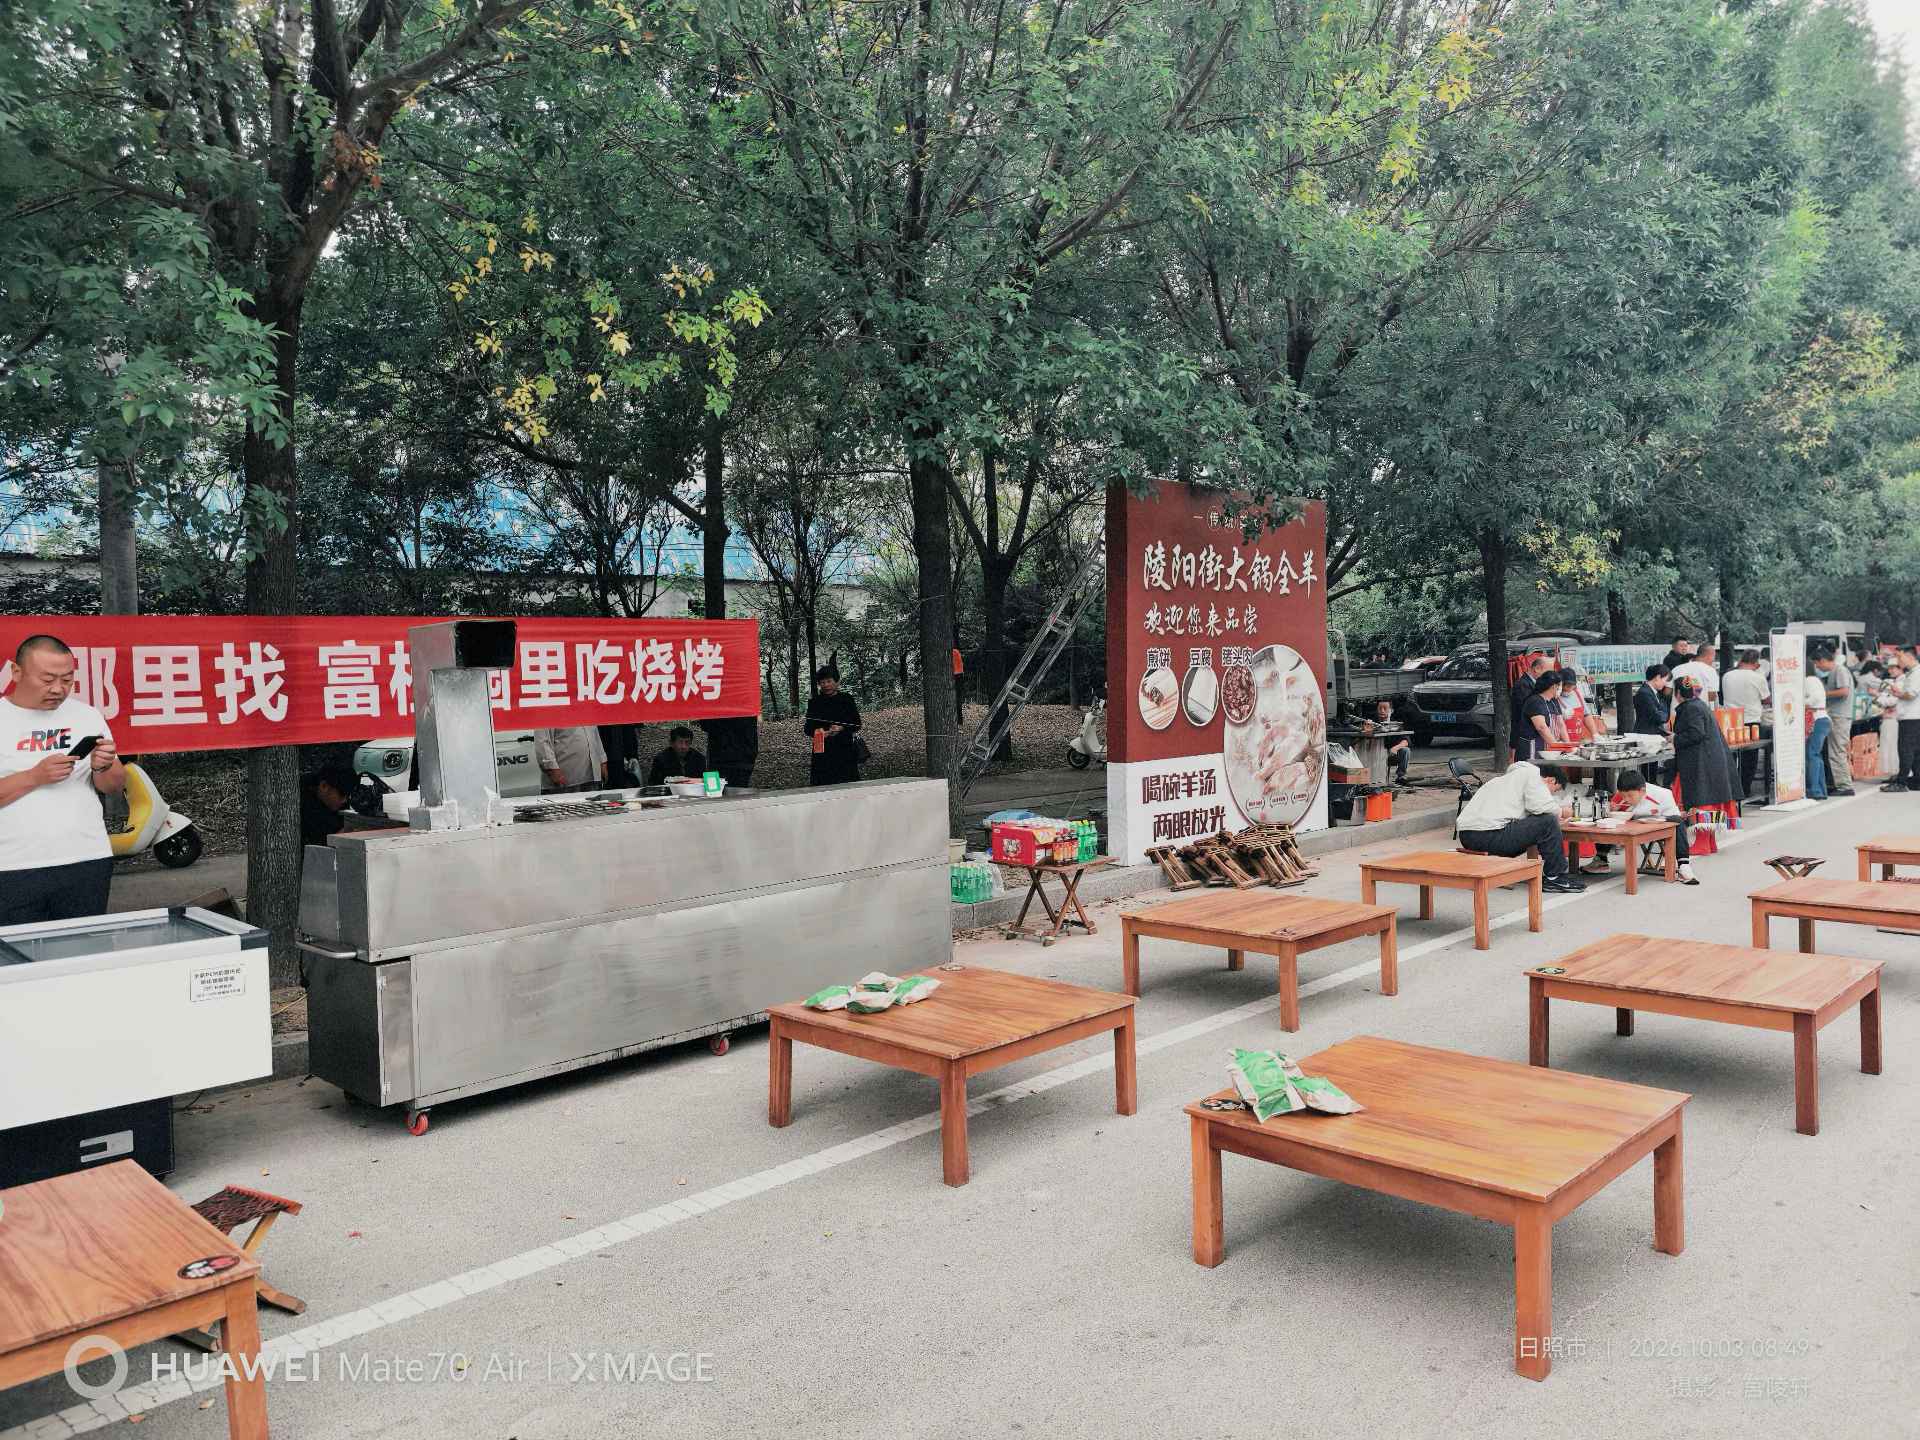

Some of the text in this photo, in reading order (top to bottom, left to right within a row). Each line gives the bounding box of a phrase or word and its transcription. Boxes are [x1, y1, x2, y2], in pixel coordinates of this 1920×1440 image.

[1143, 540, 1318, 599] 陵阳街大锅全羊
[1143, 602, 1259, 638] 欢迎您来品尝
[1147, 647, 1254, 668] 煎饼 豆腐 猪头肉
[1142, 768, 1217, 804] 喝碗羊汤
[1153, 805, 1226, 842] 两眼放光
